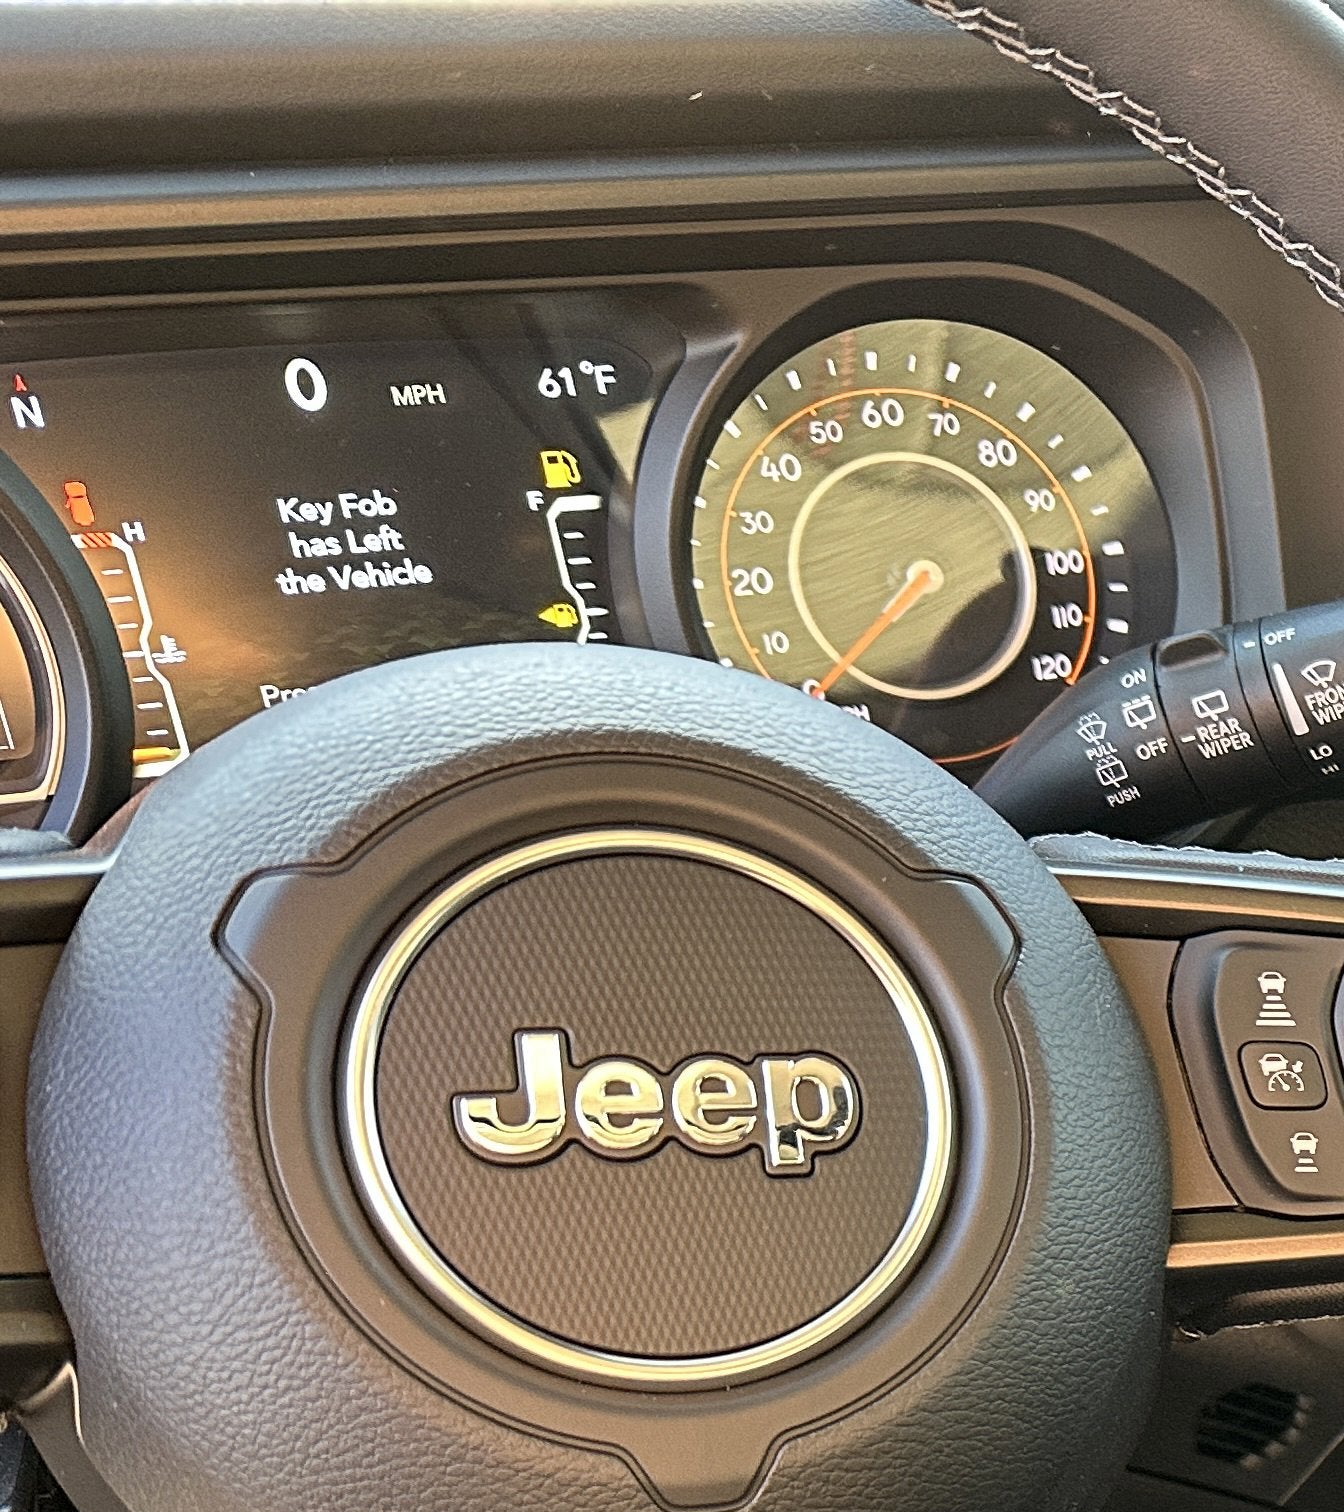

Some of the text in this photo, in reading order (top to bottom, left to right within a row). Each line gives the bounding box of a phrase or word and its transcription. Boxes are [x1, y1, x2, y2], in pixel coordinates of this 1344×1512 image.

[284, 358, 447, 412] 0 MPH
[12, 397, 45, 430] N
[861, 399, 904, 427] 60
[929, 413, 961, 435] 70
[810, 420, 844, 444] 50
[979, 439, 1017, 468] 80
[760, 454, 801, 482] 40
[277, 490, 398, 526] Key Fob
[526, 490, 545, 513] F
[1024, 490, 1055, 512] 90
[122, 521, 147, 543] H
[740, 511, 774, 535] 30
[290, 525, 407, 558] has Left
[1045, 551, 1083, 574] 100
[276, 560, 433, 595] the Vehicle
[732, 570, 774, 596] 20
[1051, 605, 1082, 628] 110
[763, 631, 789, 654] 10
[1263, 628, 1296, 646] OFF
[1032, 656, 1071, 681] 120
[1121, 669, 1148, 688] ON
[1198, 718, 1242, 742] REAR
[1086, 742, 1118, 761] PULL
[1136, 738, 1168, 761] OFF
[1198, 732, 1255, 760] WIPER
[1310, 745, 1333, 760] LO
[1107, 786, 1141, 807] PUSH
[460, 1031, 855, 1166] Jeep
